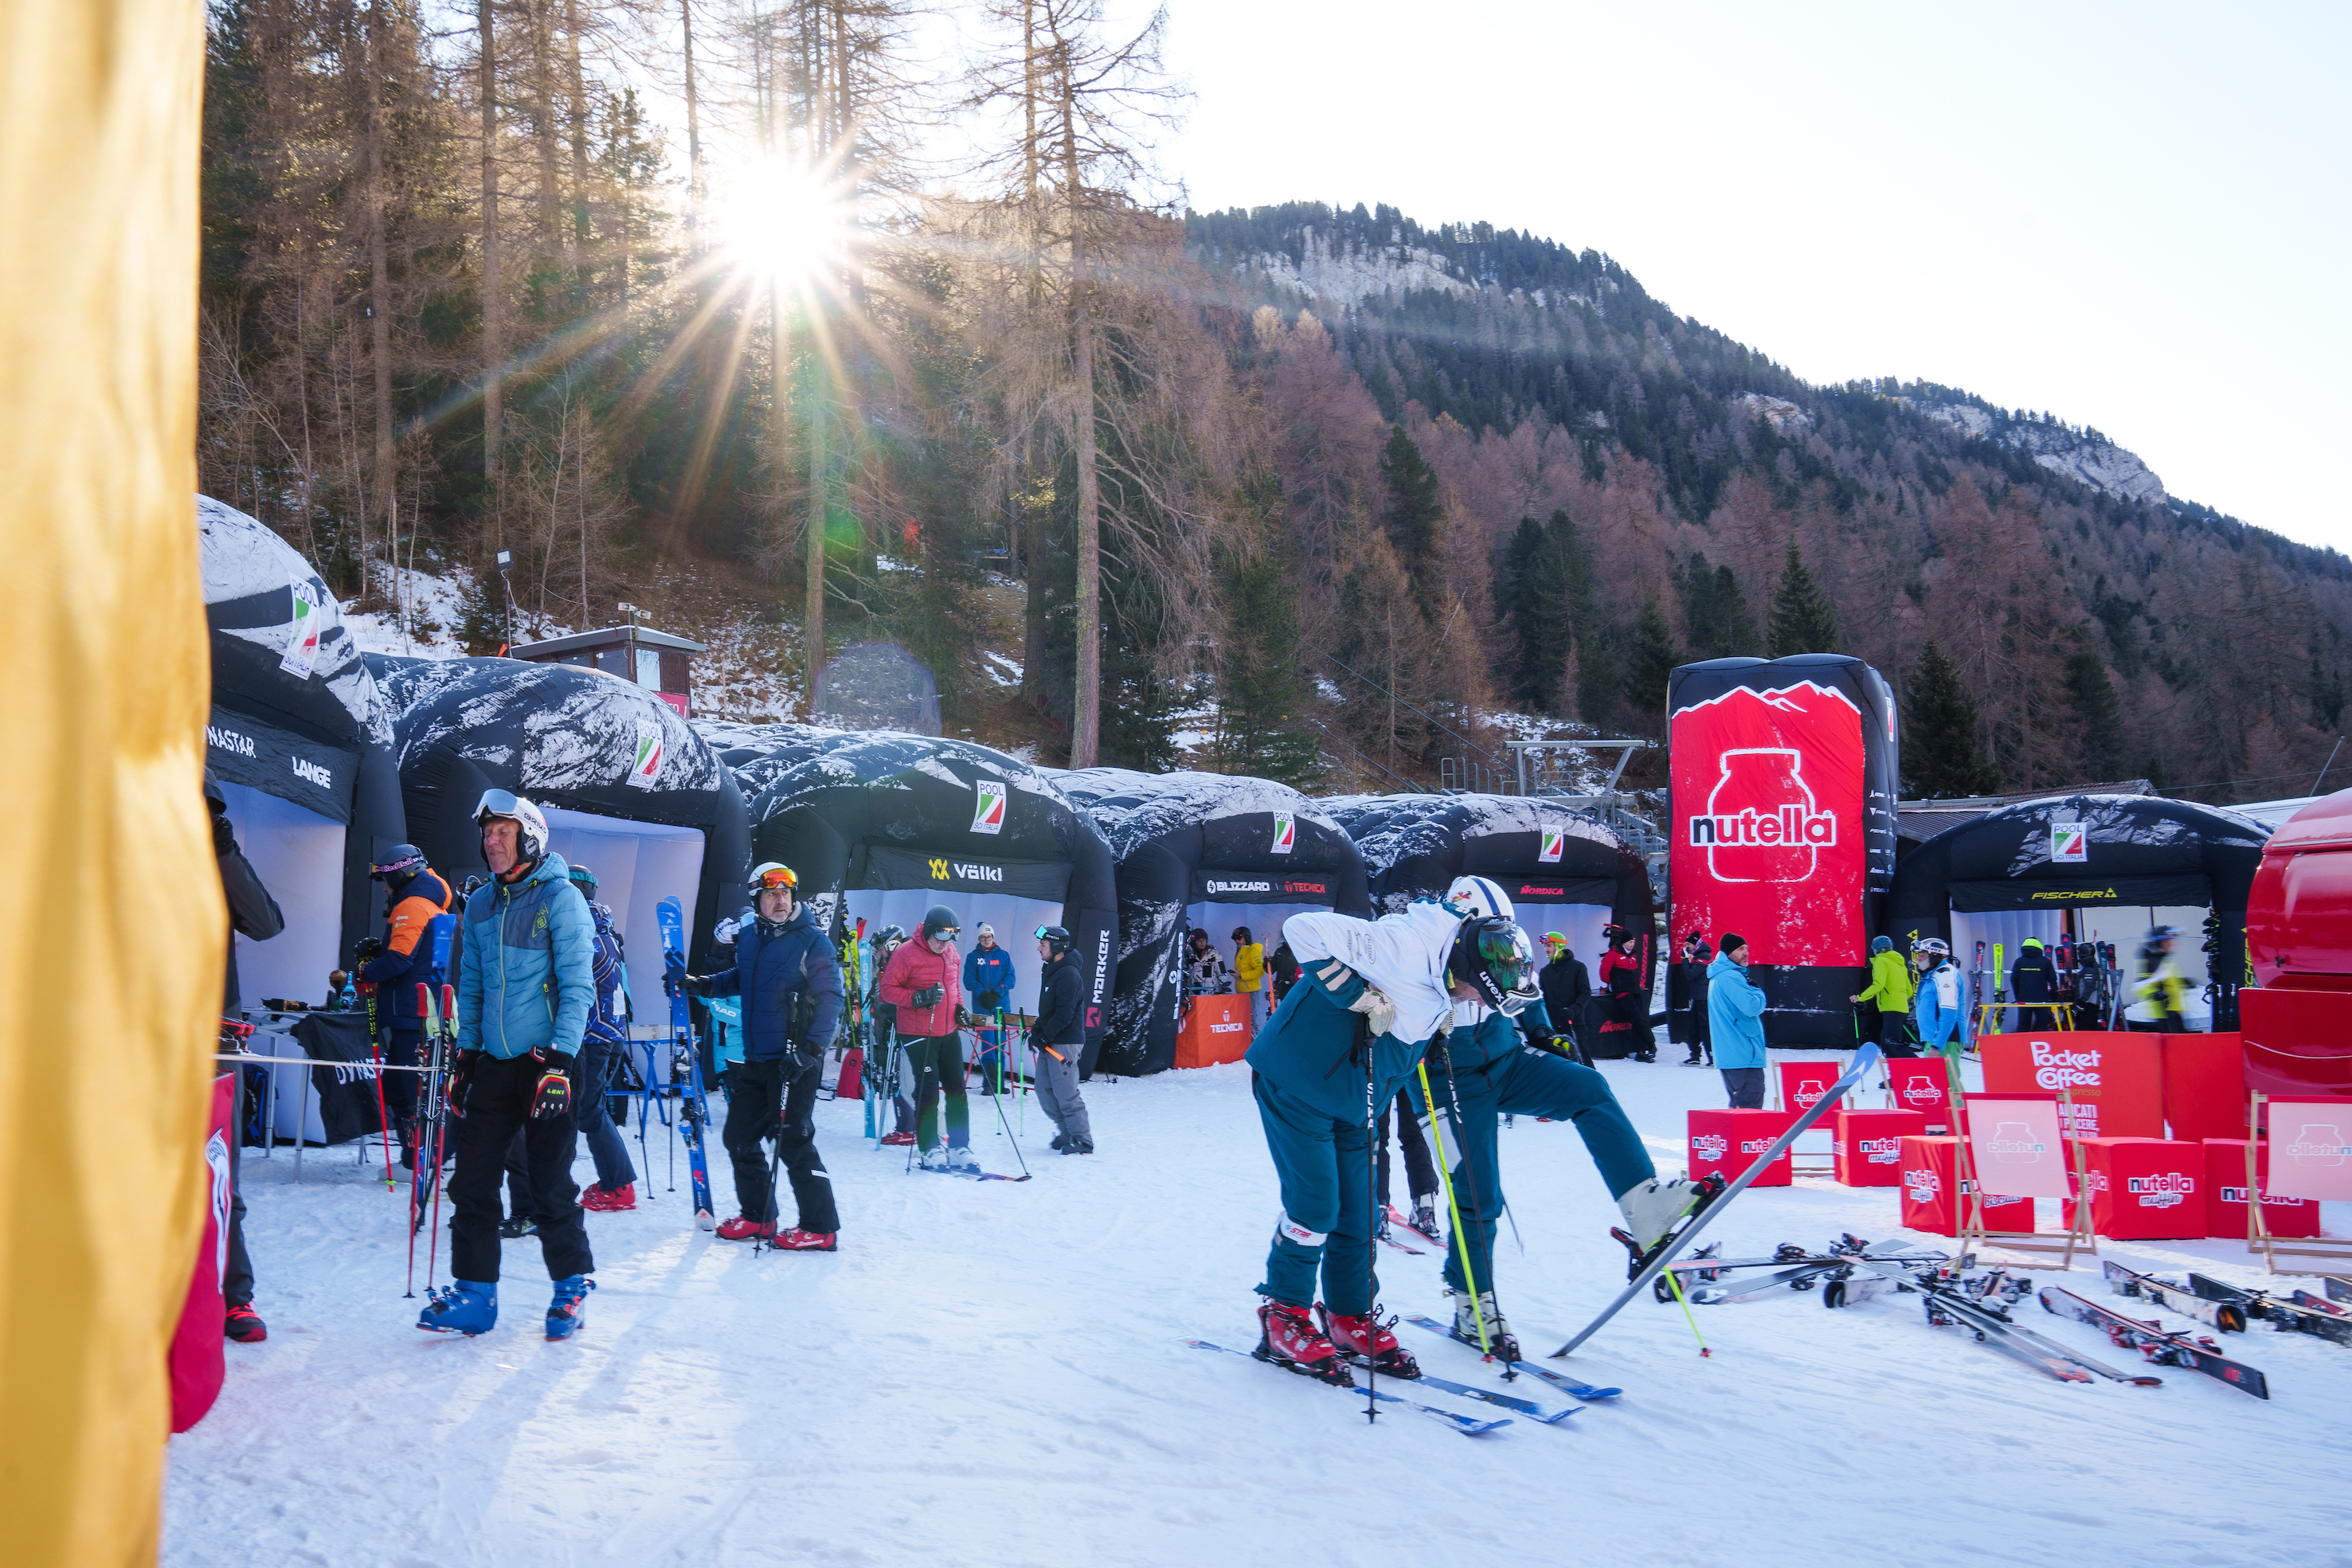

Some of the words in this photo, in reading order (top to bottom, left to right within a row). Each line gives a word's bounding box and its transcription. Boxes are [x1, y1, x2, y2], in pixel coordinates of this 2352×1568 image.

[292, 579, 318, 608] POOL
[639, 722, 661, 741] POOL
[292, 756, 331, 789] LANGE
[979, 783, 1004, 796] POOL
[523, 812, 547, 834] BRIKO
[1274, 811, 1293, 822] POOL
[984, 823, 999, 831] ITALIA
[1544, 826, 1562, 835] POOL
[1691, 805, 1835, 846] nutella
[2054, 824, 2083, 833] POOL
[384, 862, 398, 873] Red
[398, 857, 413, 868] Bull
[953, 863, 1003, 882] Völkl
[1215, 881, 1270, 892] BLIZZARD
[1292, 882, 1326, 893] TECNICA
[1520, 885, 1564, 896] NORDICA
[2031, 891, 2104, 900] FISCHER
[1092, 929, 1110, 1003] MARKER
[1479, 970, 1505, 1003] uvex
[1210, 1023, 1243, 1033] TECNICA
[2030, 1041, 2102, 1070] Pocket
[2036, 1067, 2101, 1090] Coffee
[1904, 1088, 1942, 1098] nutella
[1693, 1135, 1728, 1152] nutella
[1698, 1150, 1722, 1162] muffin
[1904, 1170, 1940, 1191] nutella
[2128, 1173, 2194, 1193] nutella
[1910, 1189, 1935, 1203] muffin
[2139, 1193, 2183, 1209] muffin
